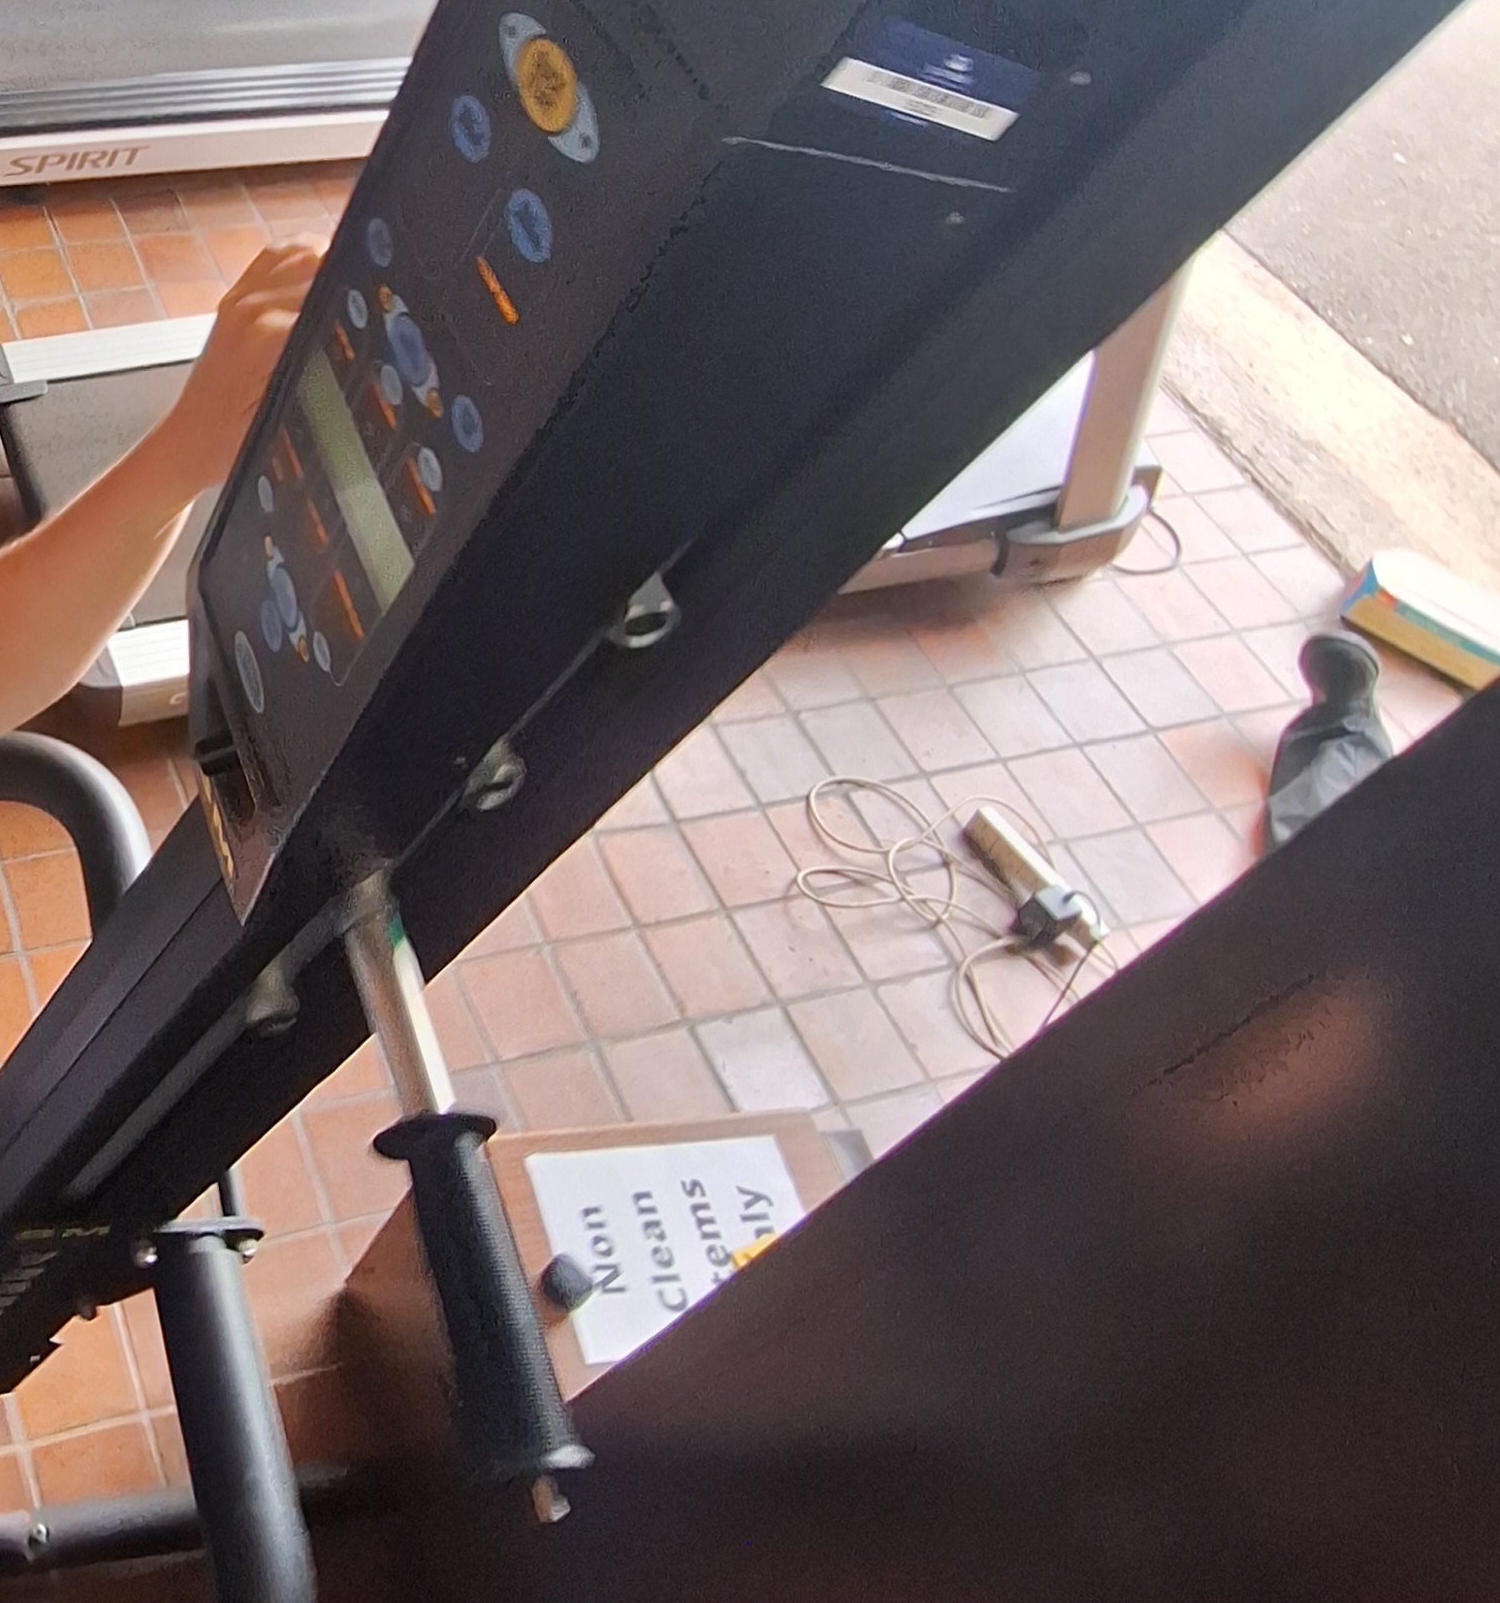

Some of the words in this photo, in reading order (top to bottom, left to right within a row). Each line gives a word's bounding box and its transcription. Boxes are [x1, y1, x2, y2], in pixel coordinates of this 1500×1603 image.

[3, 145, 150, 177] SPIRIT
[580, 1204, 627, 1296] Non
[632, 1190, 689, 1313] Clean
[680, 1178, 737, 1286] tems
